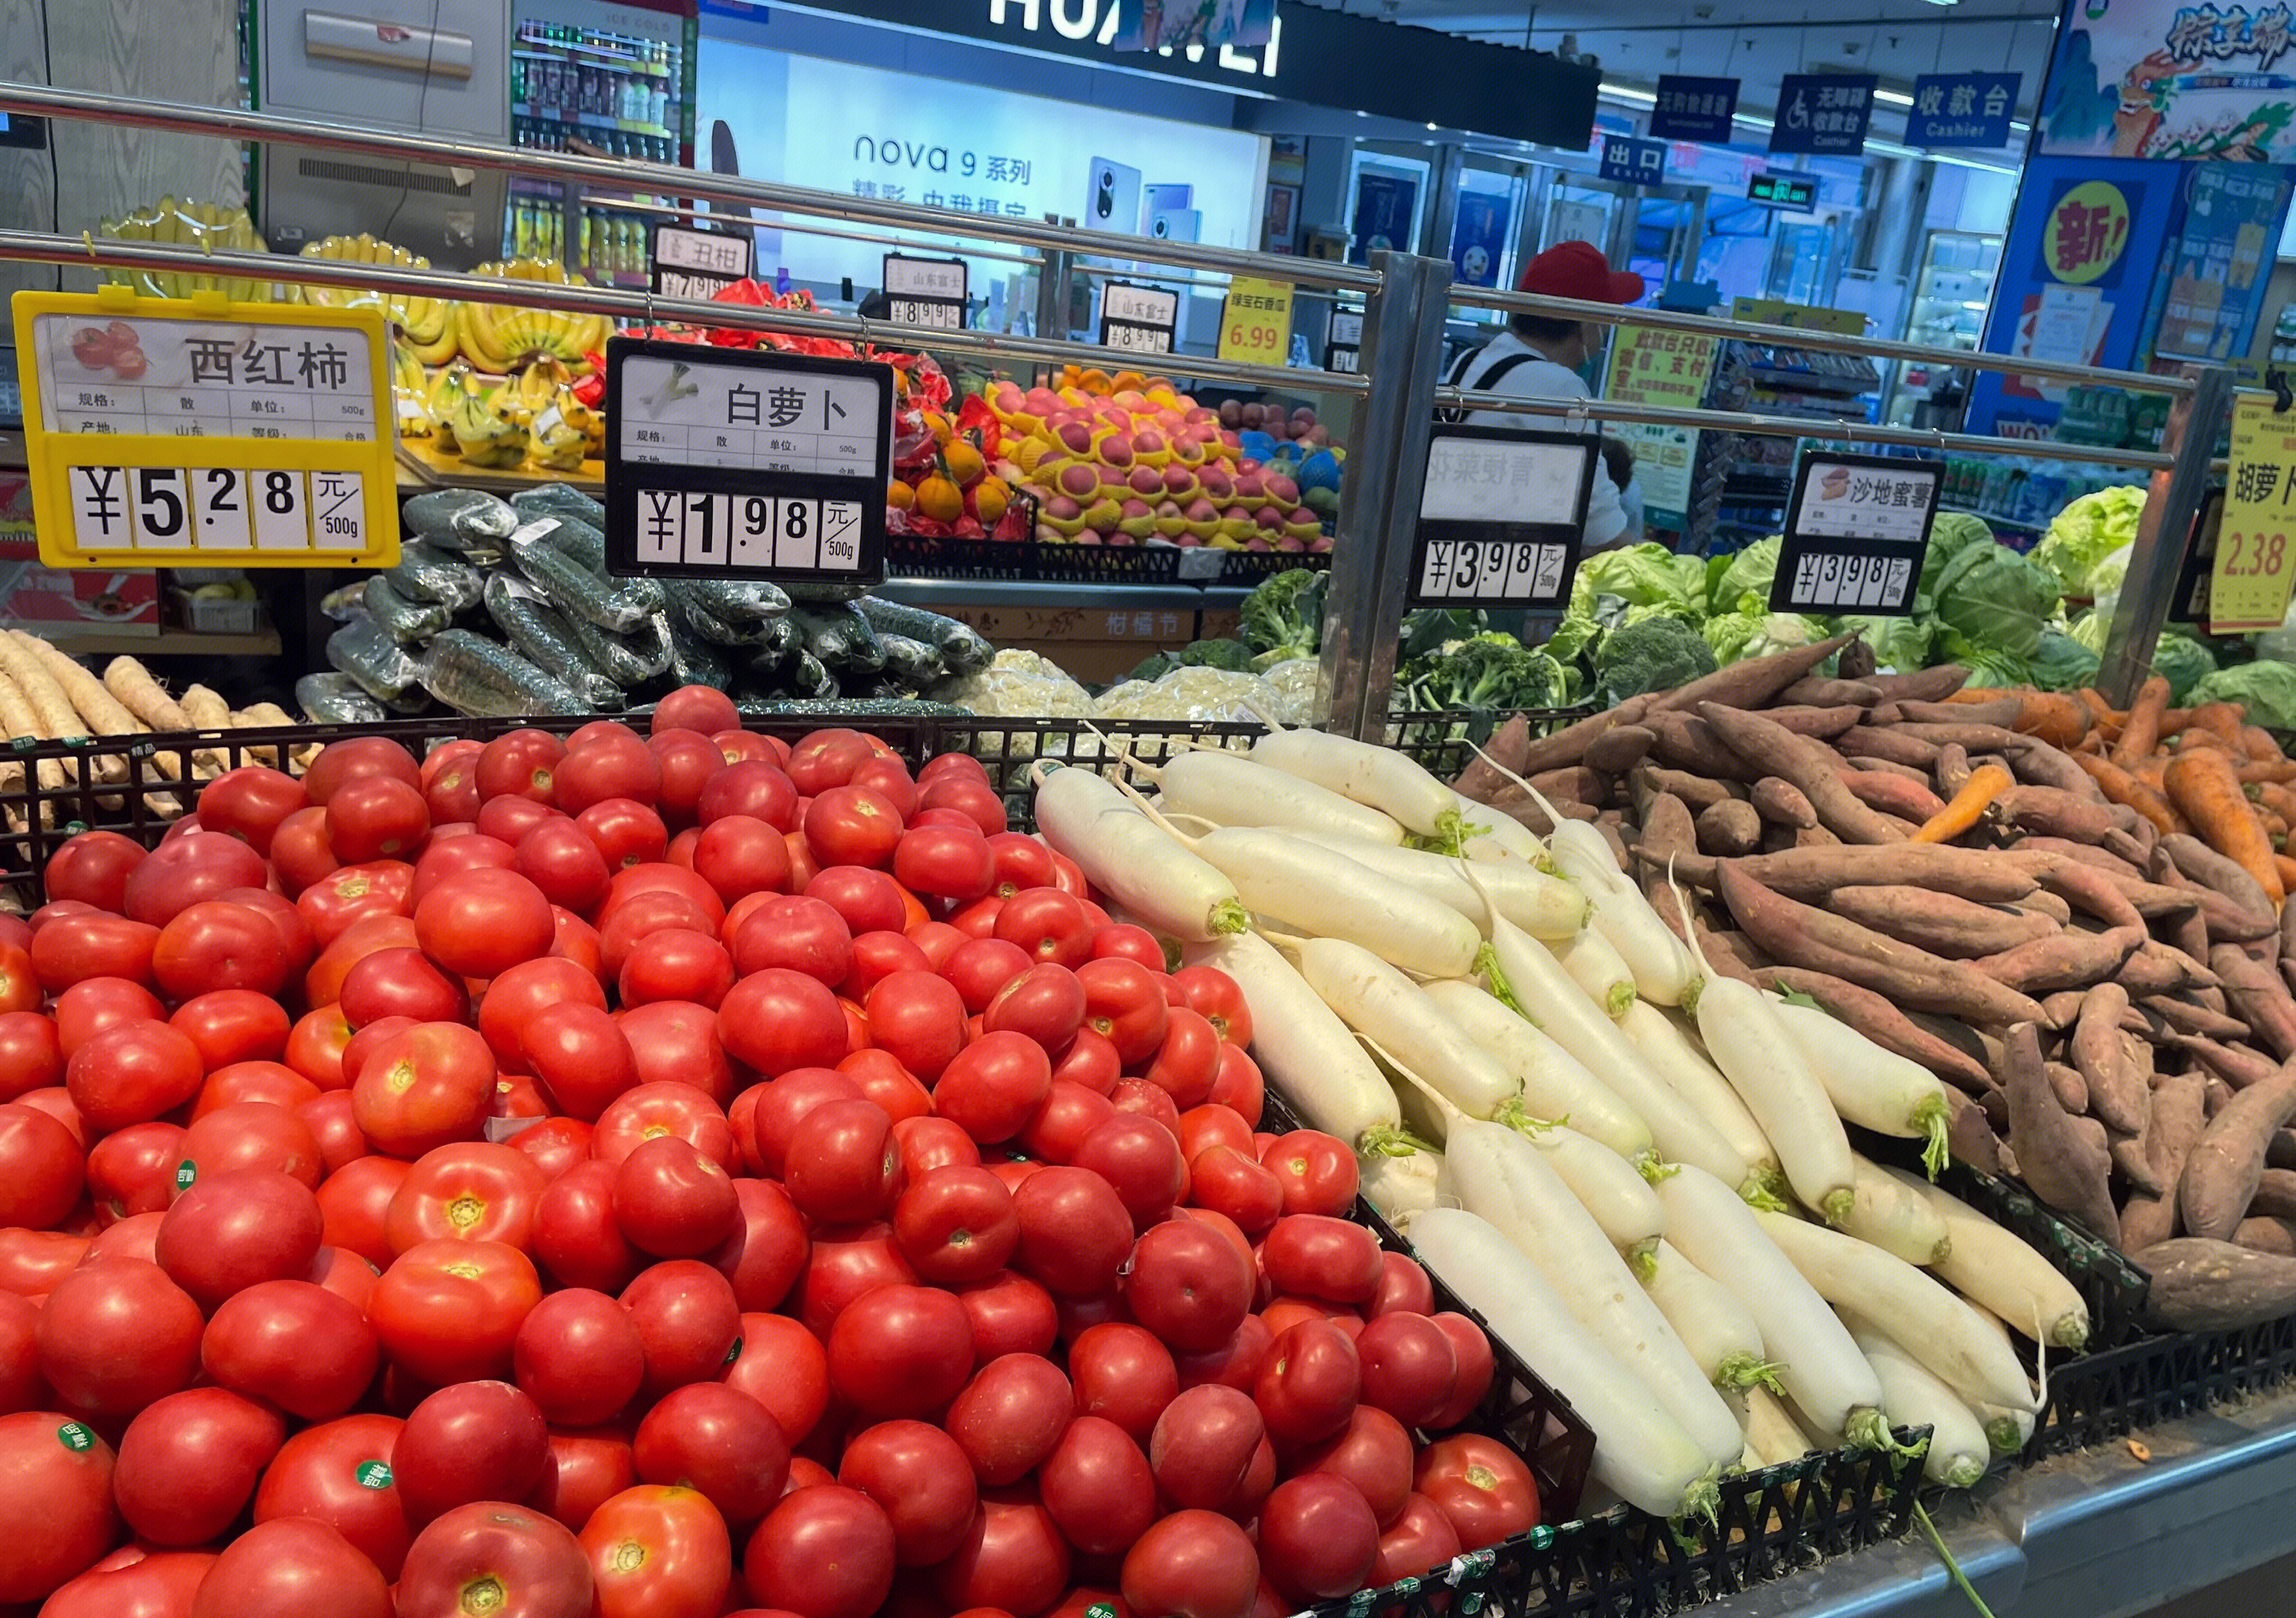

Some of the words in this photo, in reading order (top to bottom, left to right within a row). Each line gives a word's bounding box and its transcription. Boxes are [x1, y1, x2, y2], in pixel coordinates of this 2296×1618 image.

[2166, 2, 2296, 71] 粽享端
[1919, 84, 2009, 117] 收款台
[1813, 111, 1860, 133] 收款台
[1926, 121, 1985, 137] Cashier
[854, 135, 949, 173] nova
[961, 150, 977, 177] 9
[986, 154, 1032, 186] 系列
[1608, 144, 1661, 170] 出口
[692, 241, 737, 269] 丑柑
[913, 272, 961, 288] 山东富士
[1231, 324, 1277, 350] 6.99
[185, 338, 348, 390] 西红柿
[341, 404, 365, 416] 500g
[727, 383, 847, 431] 白萝卜
[839, 444, 857, 455] 500g
[1850, 476, 1934, 509] 沙地蜜薯
[2225, 531, 2286, 576] 2.38
